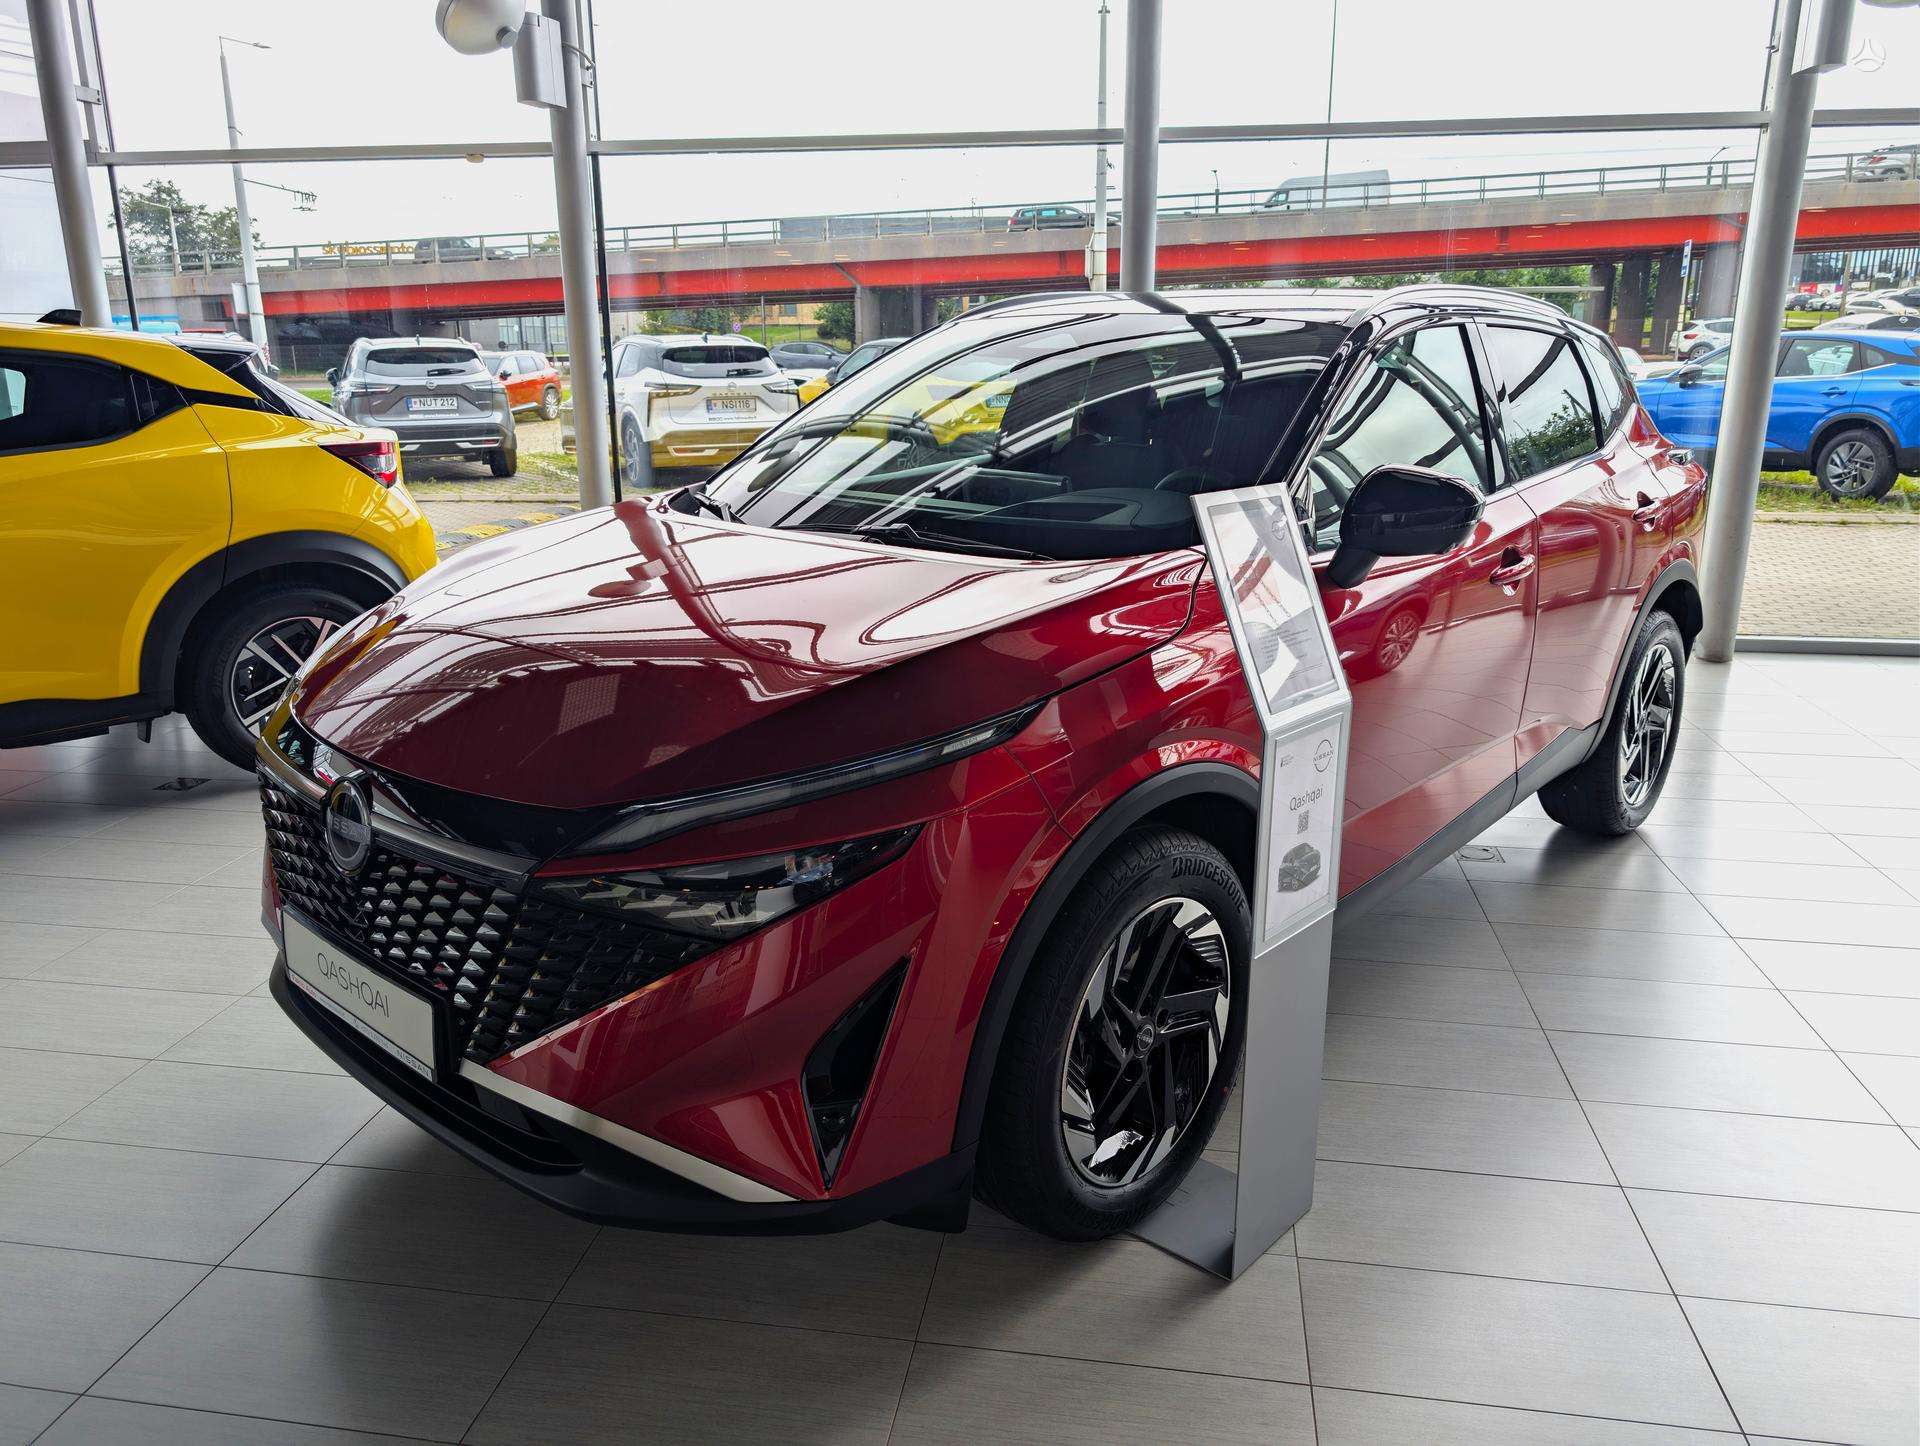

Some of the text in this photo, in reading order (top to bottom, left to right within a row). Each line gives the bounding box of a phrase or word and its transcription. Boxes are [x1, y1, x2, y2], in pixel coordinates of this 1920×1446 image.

[419, 398, 455, 407] NUT 212
[1313, 749, 1335, 763] NISSAN
[1289, 784, 1324, 811] Qashqai
[1171, 856, 1246, 913] BRIDGESTONE
[317, 952, 390, 1018] QASHQAI
